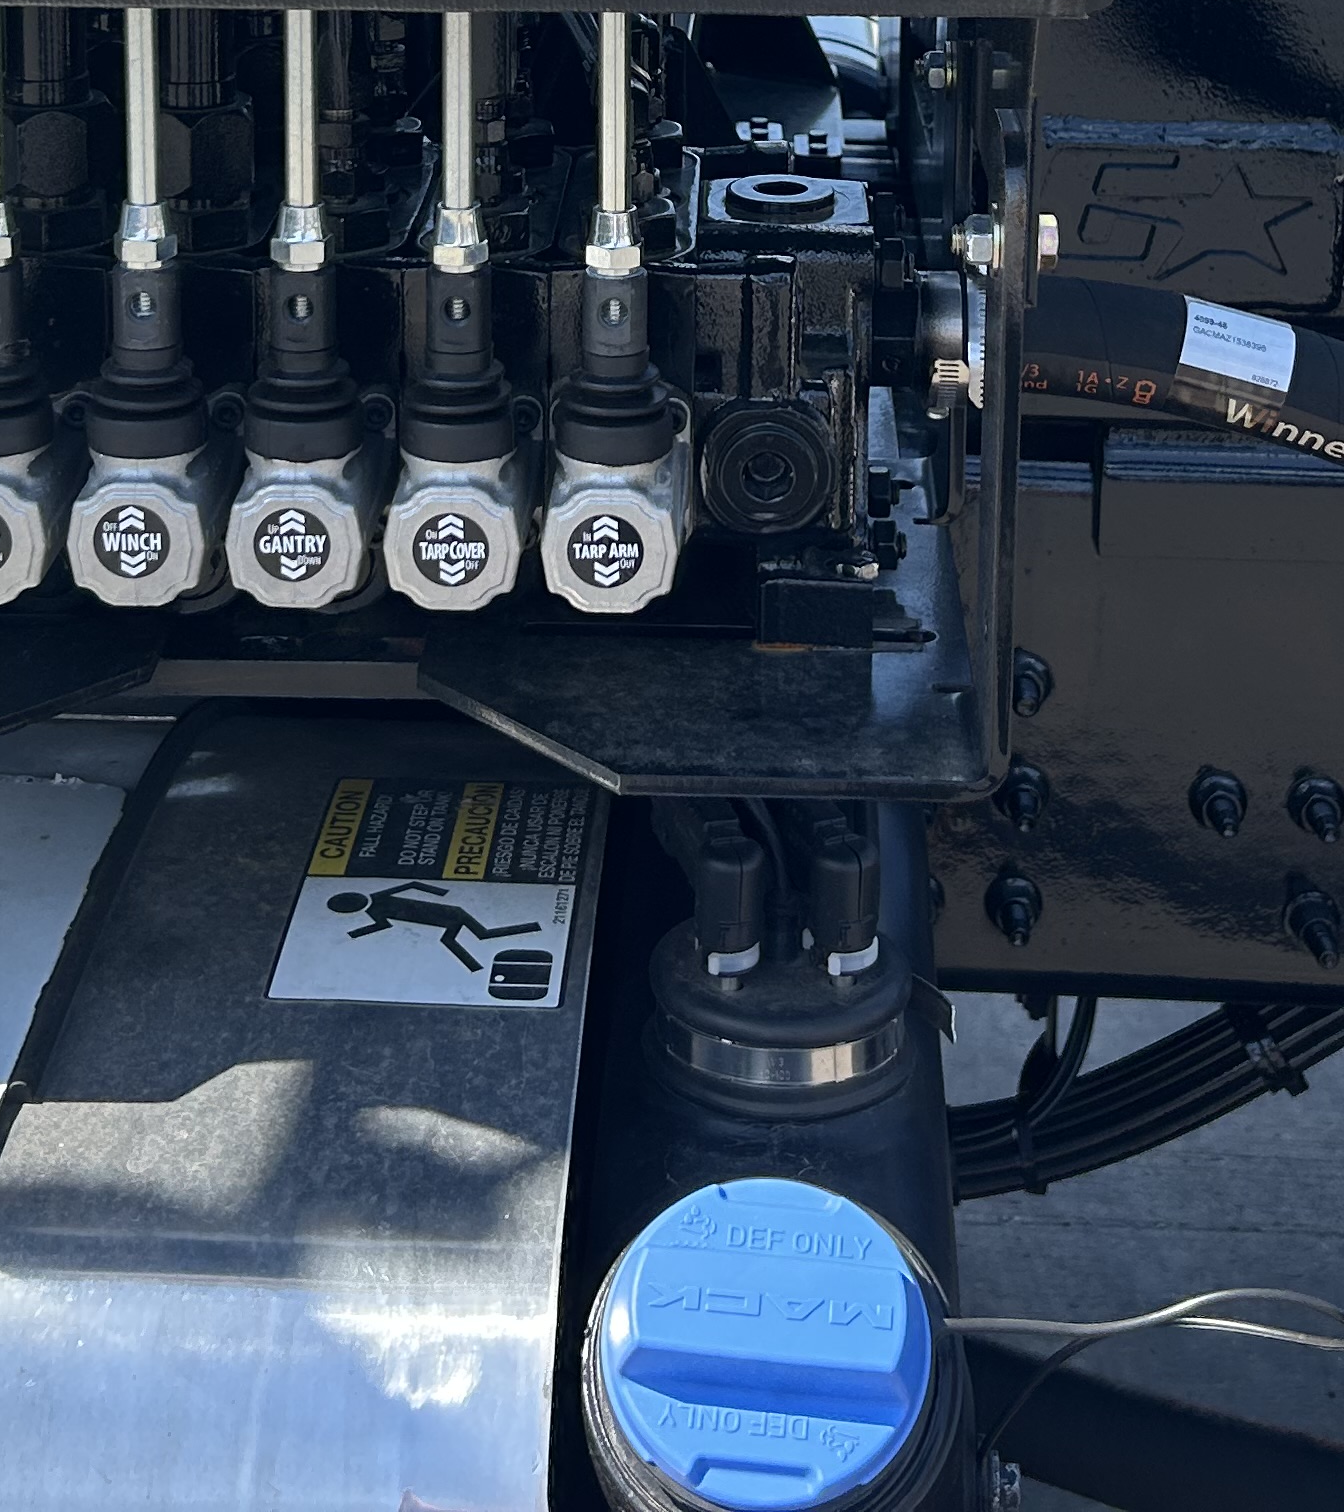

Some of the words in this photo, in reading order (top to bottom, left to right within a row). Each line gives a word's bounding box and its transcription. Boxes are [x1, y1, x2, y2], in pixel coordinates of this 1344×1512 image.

[102, 532, 162, 551] WINCH
[259, 535, 327, 554] GANTRY
[573, 542, 607, 559] TARP
[608, 542, 639, 558] ARM
[531, 793, 548, 806] DE
[320, 789, 364, 859] CAUTION
[408, 803, 428, 827] STEP
[426, 817, 443, 831] ON
[526, 806, 545, 831] USAR
[403, 829, 421, 849] NOT
[498, 823, 518, 836] DE
[359, 835, 382, 858] FALL
[420, 833, 441, 866] STAND
[562, 827, 584, 854] SOBRE
[398, 851, 416, 865] DO
[560, 855, 579, 869] PIE
[557, 870, 577, 882] DE
[726, 1224, 784, 1251] DEF
[792, 1234, 872, 1261] ONLY
[648, 1282, 894, 1331] MACK
[657, 1403, 741, 1433] ONLY
[748, 1412, 810, 1441] DEF
